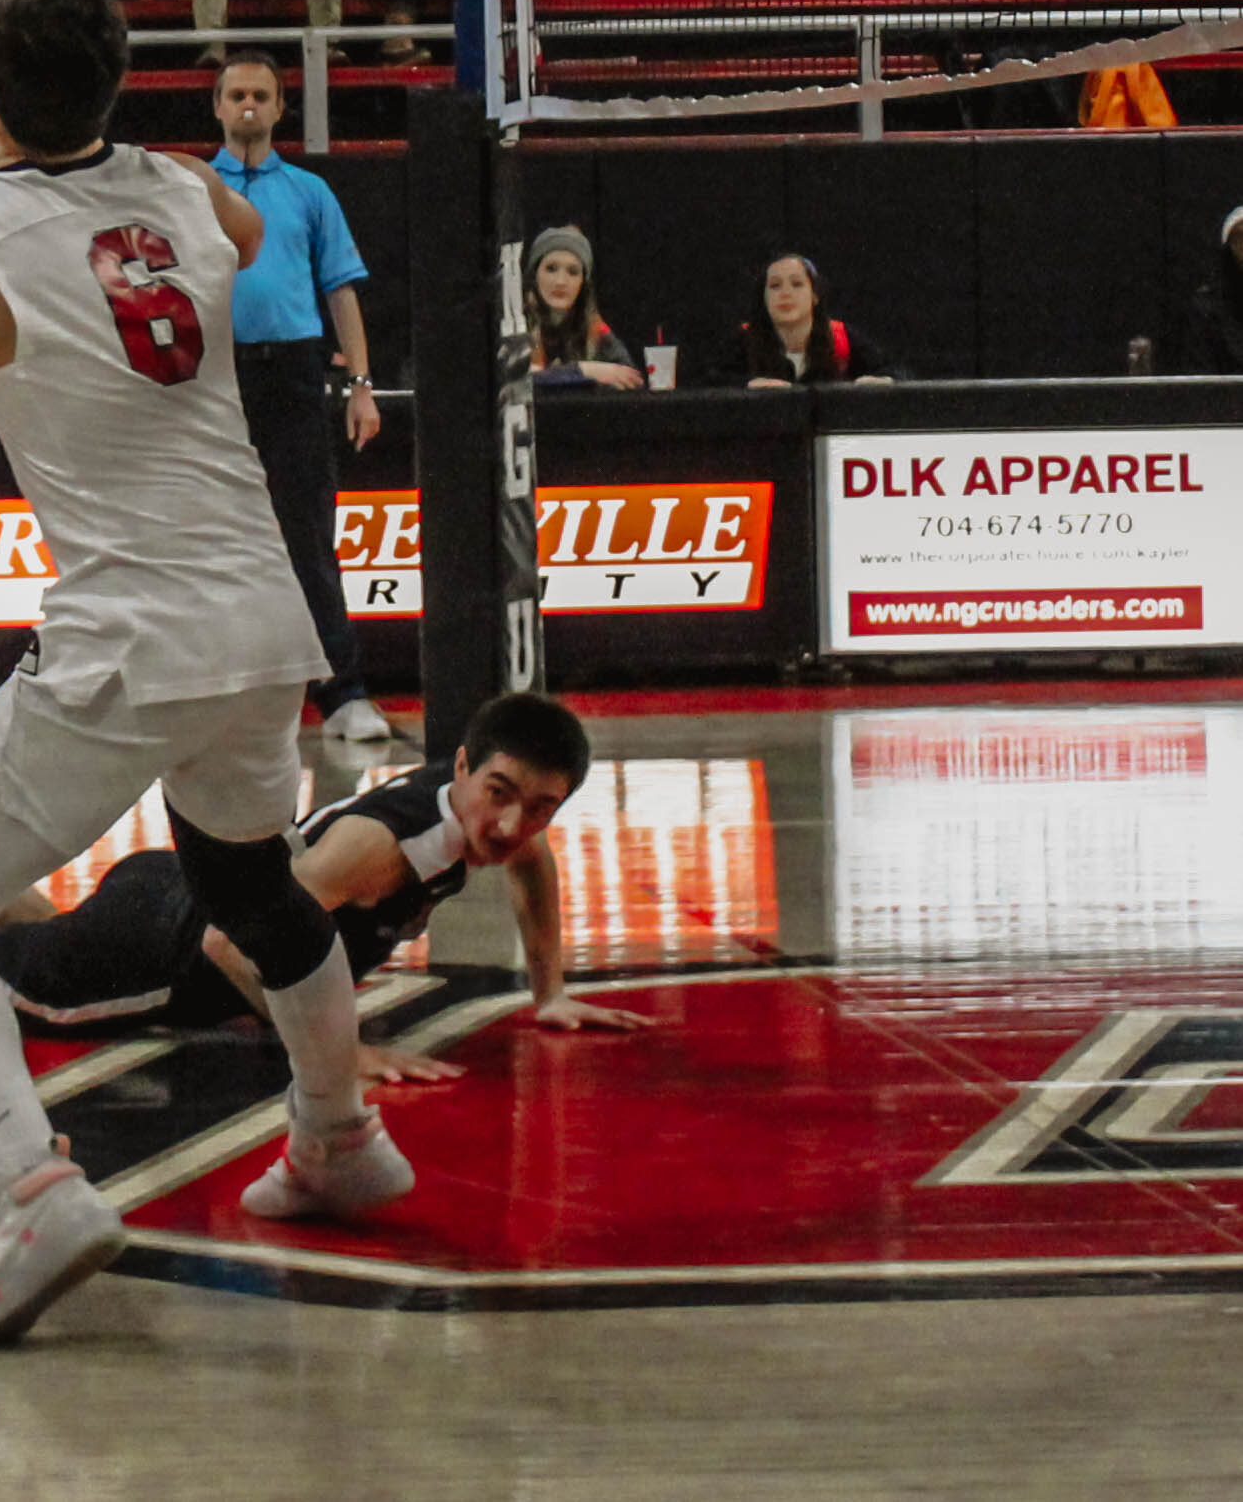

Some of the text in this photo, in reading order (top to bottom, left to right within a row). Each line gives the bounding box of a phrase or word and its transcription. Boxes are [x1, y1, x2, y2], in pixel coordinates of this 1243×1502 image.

[88, 222, 204, 386] 6
[843, 453, 1204, 499] DLK APPAREL
[917, 513, 1134, 538] 704-674-5770
[866, 596, 1185, 627] www.ngcrusaders.com
